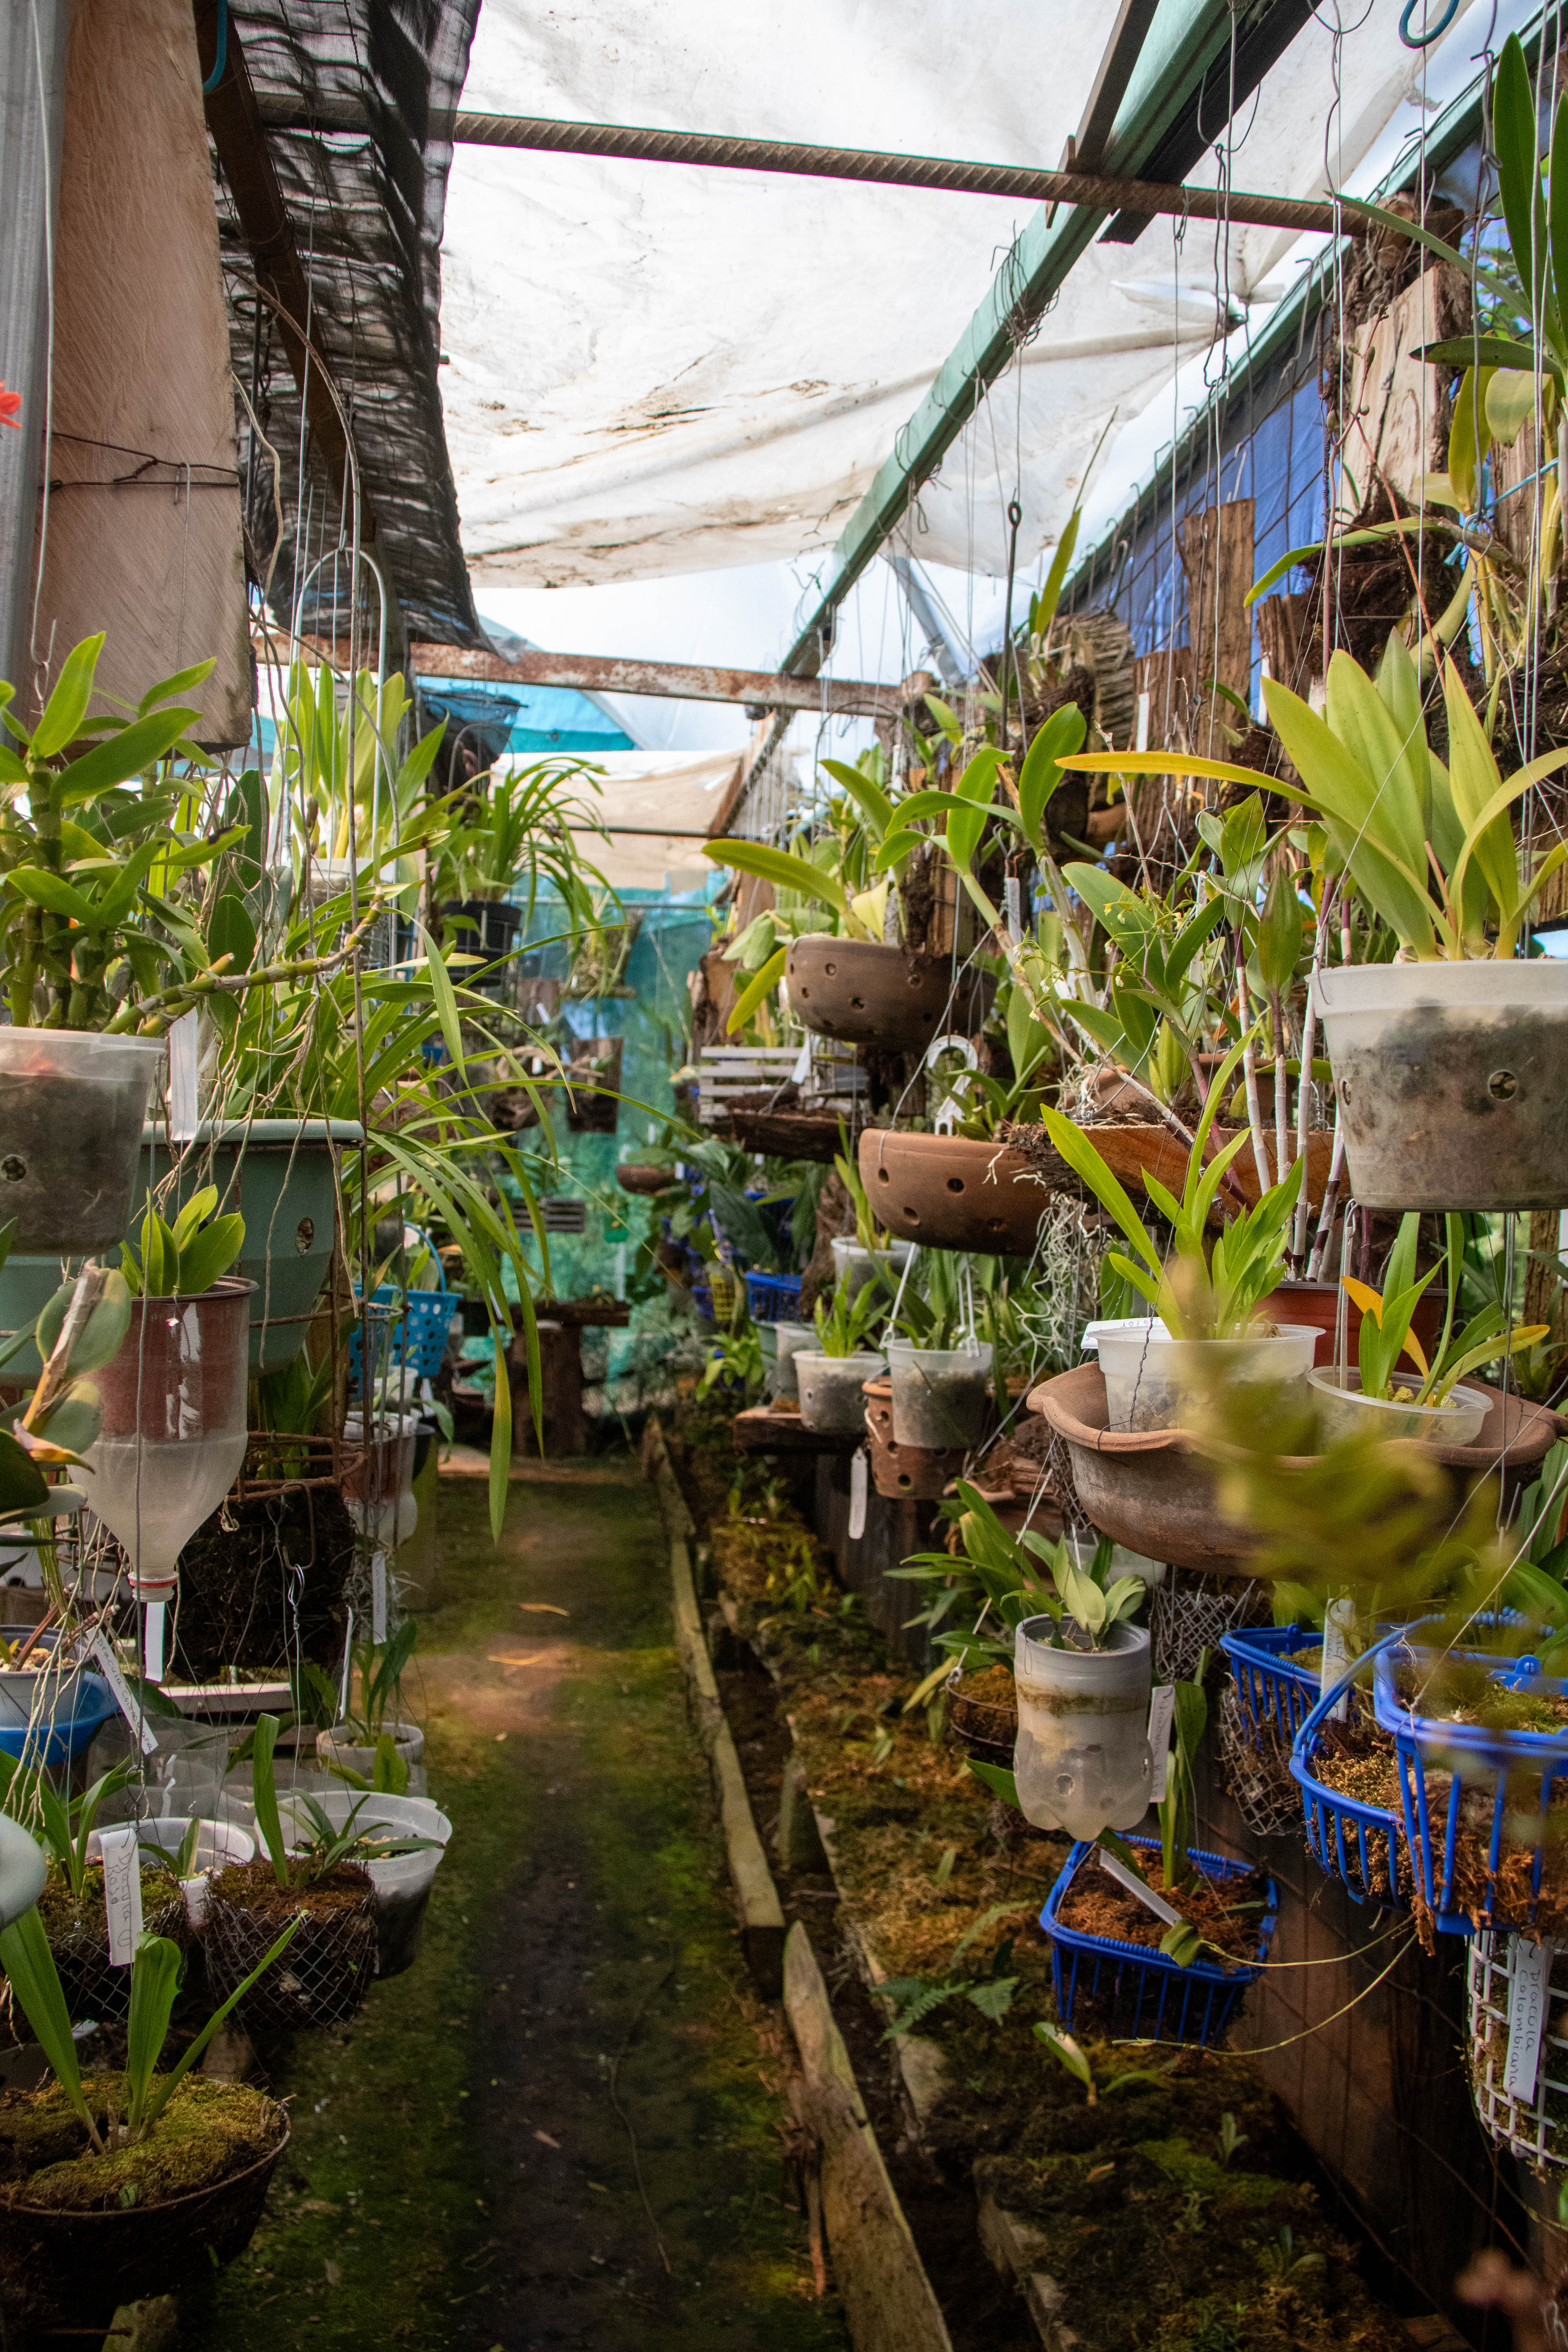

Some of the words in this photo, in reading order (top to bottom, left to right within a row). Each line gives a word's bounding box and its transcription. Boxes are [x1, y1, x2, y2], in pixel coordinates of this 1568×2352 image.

[97, 1639, 122, 1685] Dracula
[1509, 1969, 1528, 2087] Colombiana
[1526, 1969, 1540, 2053] Dracula
